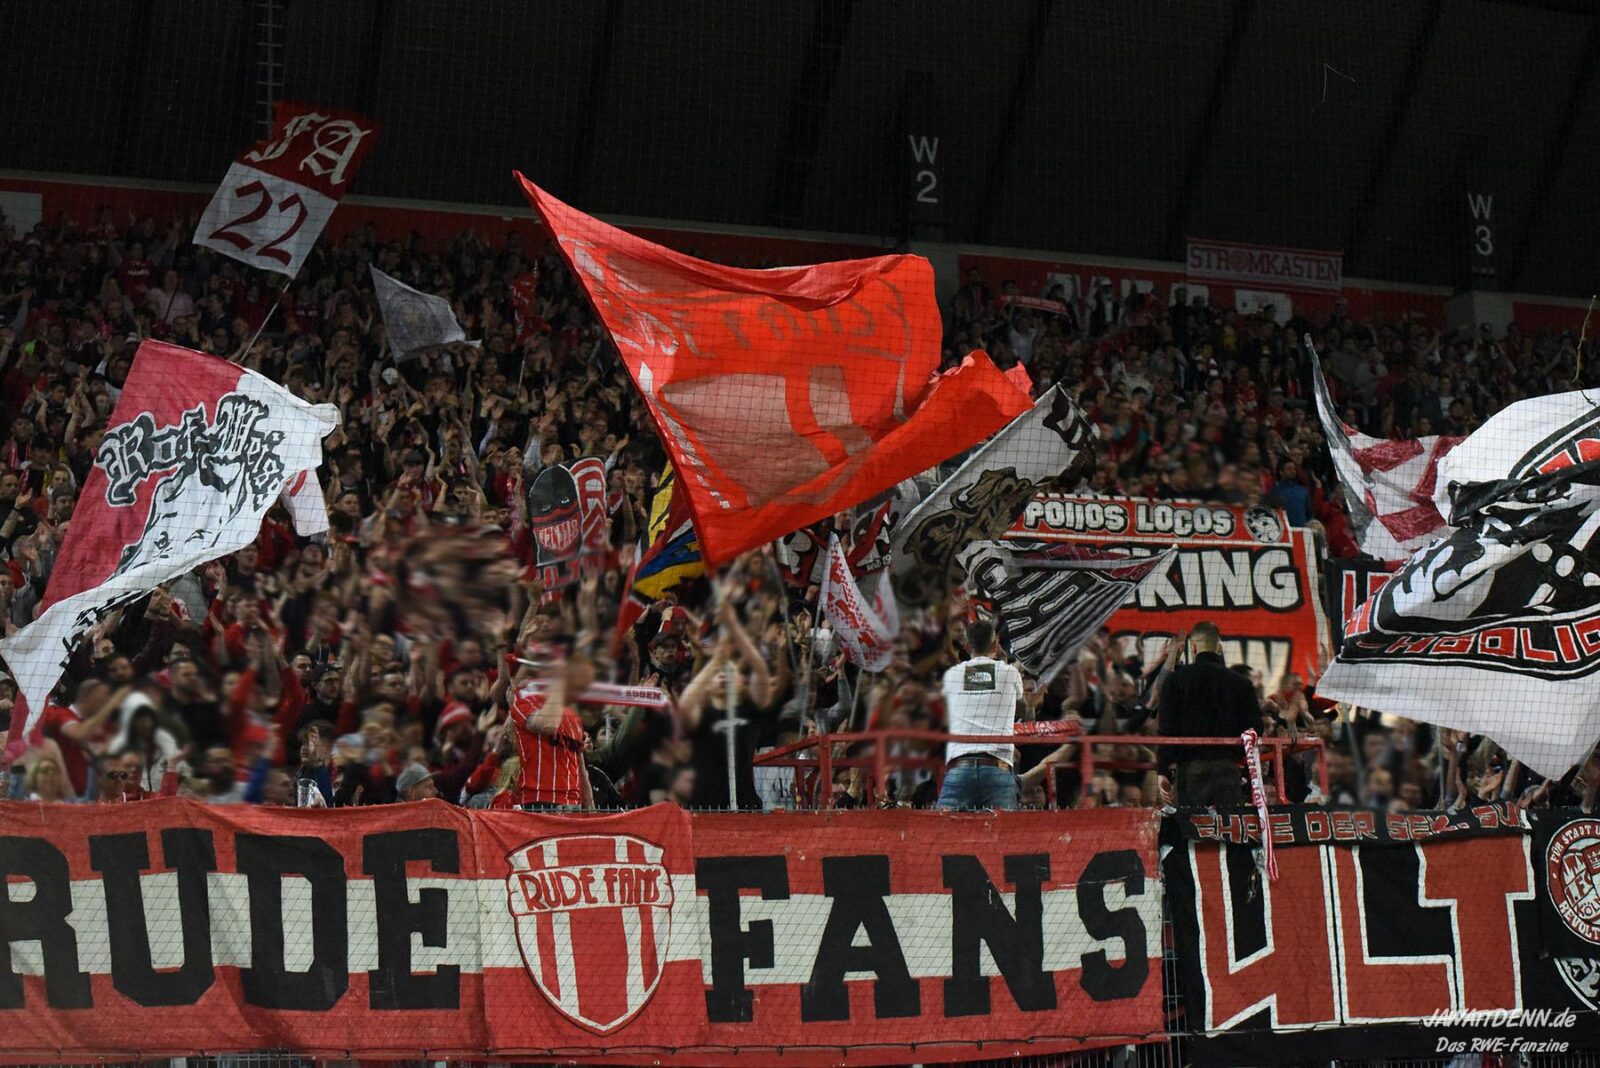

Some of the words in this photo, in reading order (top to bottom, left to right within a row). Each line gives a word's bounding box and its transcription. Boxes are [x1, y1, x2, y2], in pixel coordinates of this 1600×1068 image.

[909, 134, 939, 163] W
[916, 171, 939, 203] 2
[1467, 192, 1493, 219] W
[208, 180, 309, 267] 22
[1475, 225, 1493, 256] 3
[1305, 811, 1380, 843] DER
[1562, 824, 1592, 845] STADT
[518, 868, 598, 911] RUDE
[603, 868, 661, 905] FANS
[0, 827, 460, 1010] RUDE
[696, 849, 1149, 1022] FANS
